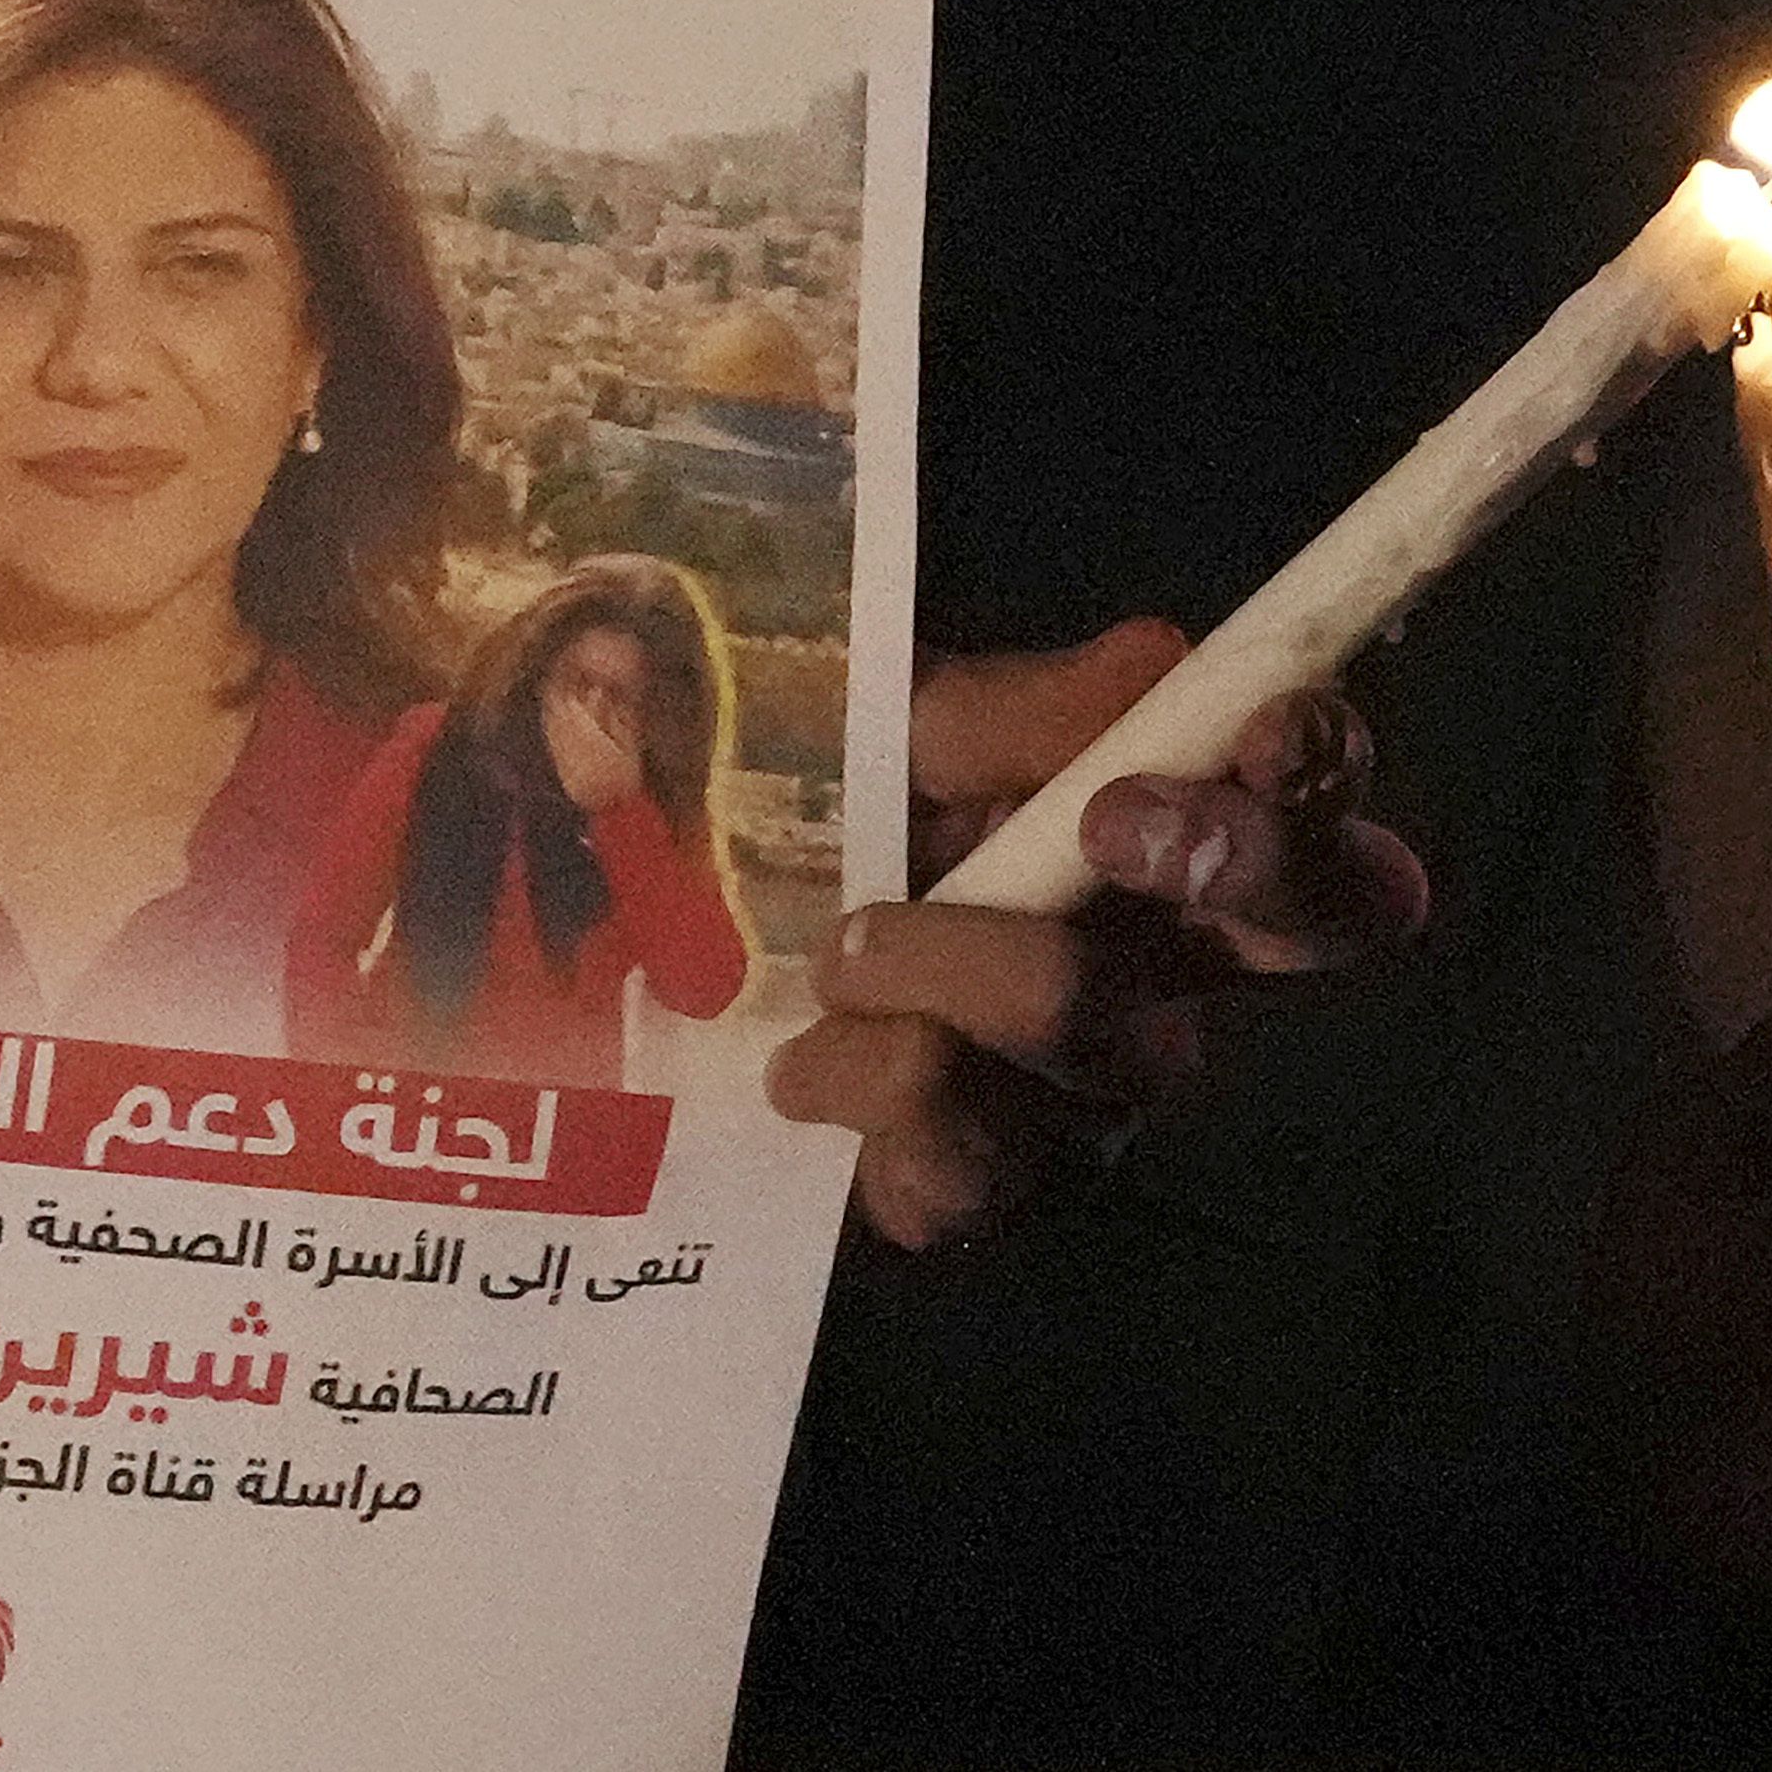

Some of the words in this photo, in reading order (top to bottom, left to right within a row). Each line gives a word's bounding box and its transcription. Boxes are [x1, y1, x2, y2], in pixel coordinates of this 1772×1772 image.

[83, 1084, 298, 1167] دعم
[339, 1071, 560, 1202] لجنة
[26, 1199, 269, 1269] الصحفية
[287, 1229, 465, 1289] الأسرة
[479, 1244, 572, 1306] إلى
[585, 1242, 715, 1303] تنعى
[308, 1361, 560, 1425] الصحافية
[106, 1450, 215, 1503] قناة
[235, 1456, 422, 1524] مراسلة
